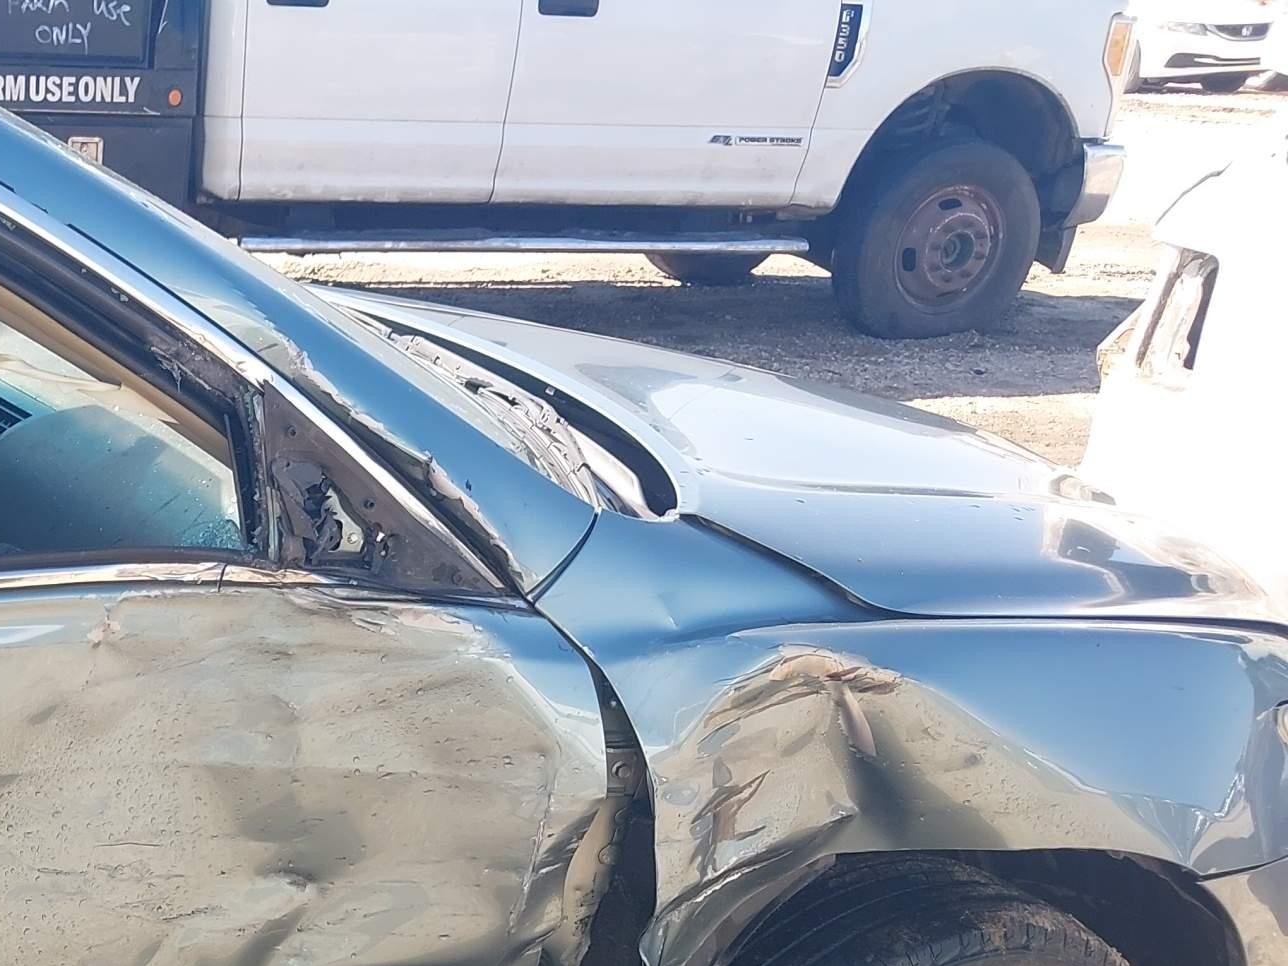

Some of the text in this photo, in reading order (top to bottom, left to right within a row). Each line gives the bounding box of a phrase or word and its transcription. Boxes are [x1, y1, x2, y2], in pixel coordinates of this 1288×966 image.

[35, 22, 92, 55] ONLY
[29, 75, 76, 103] USE
[78, 76, 141, 103] ONLY
